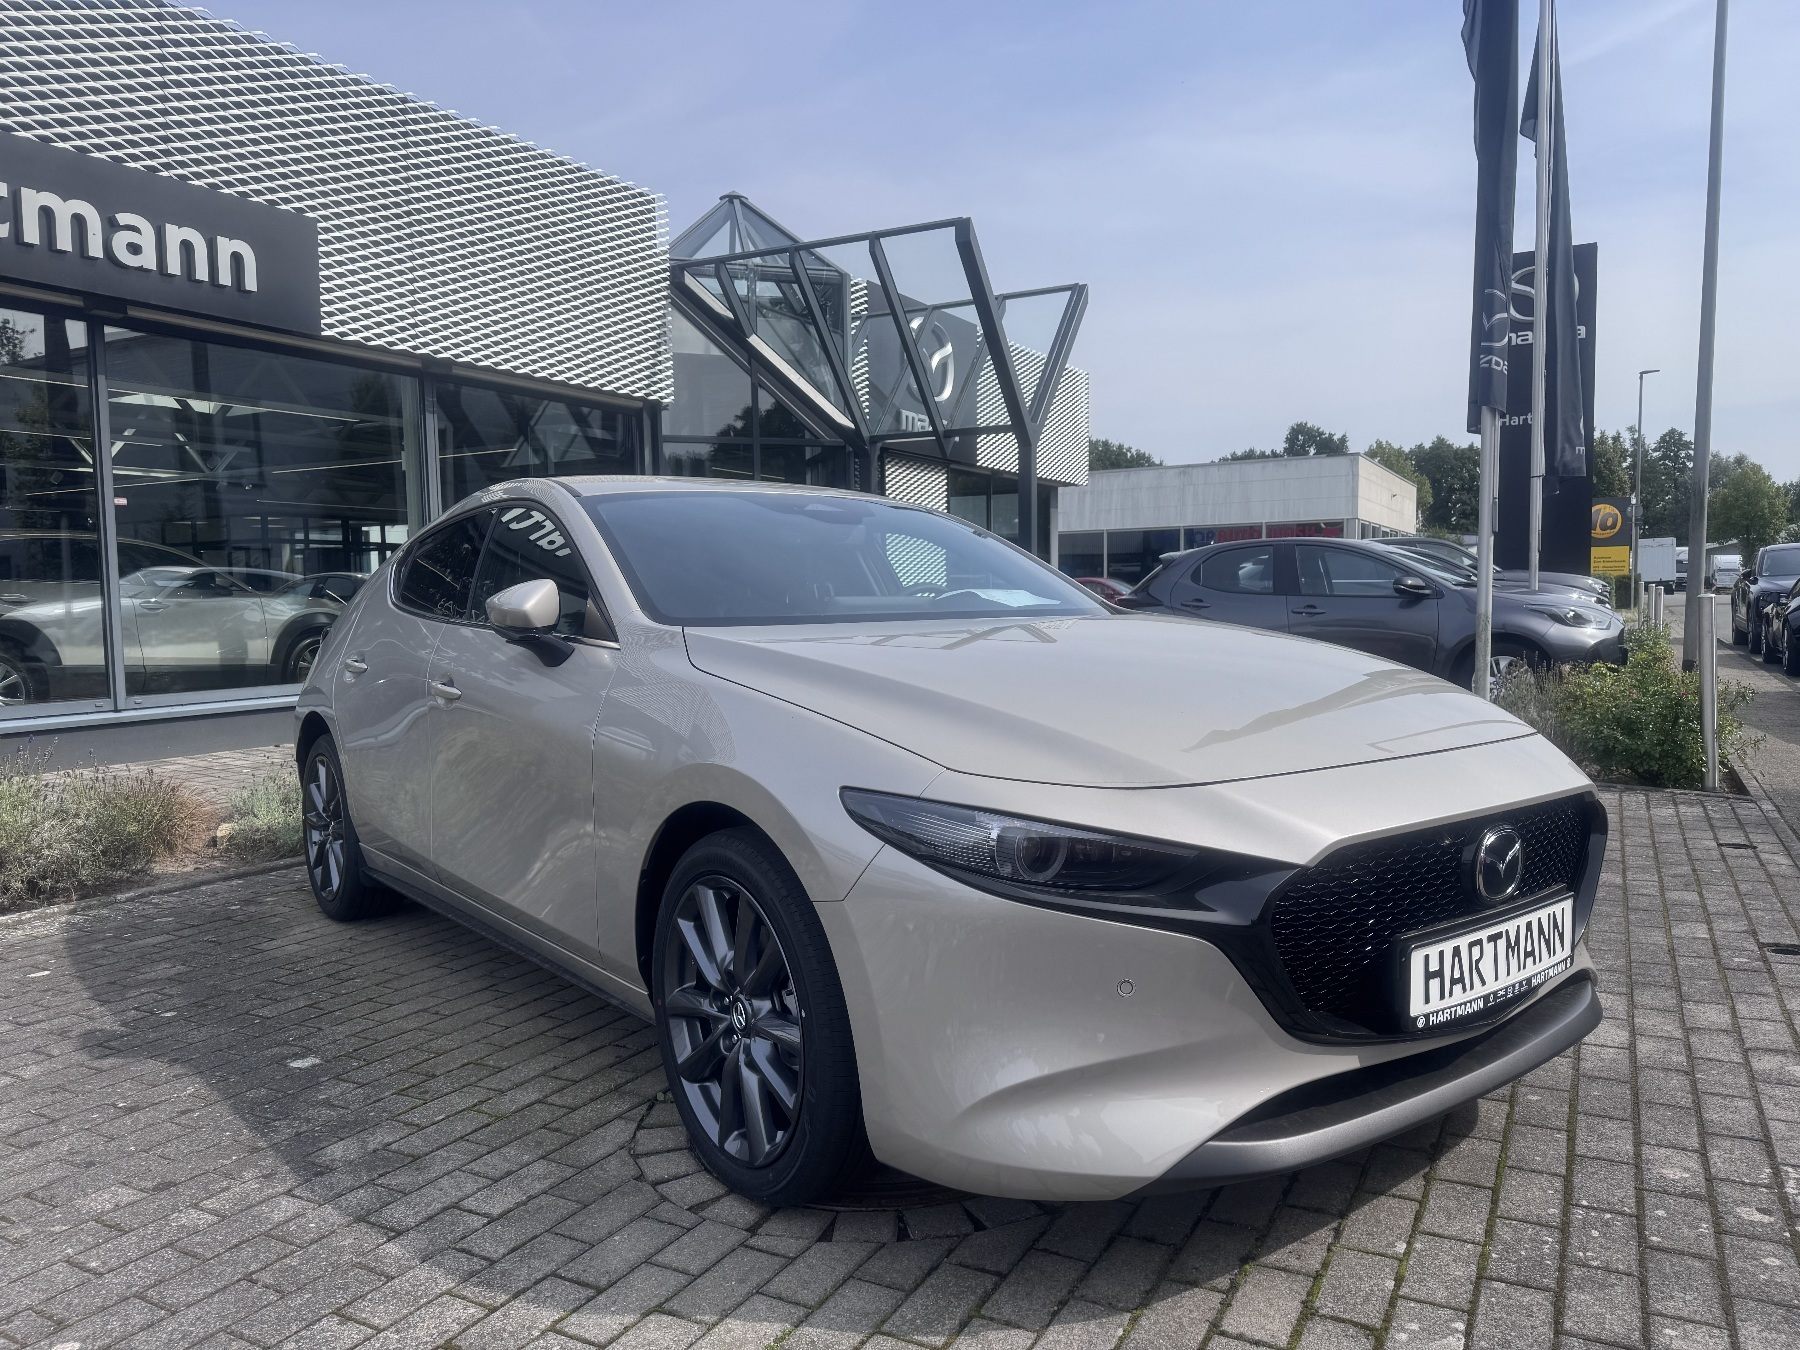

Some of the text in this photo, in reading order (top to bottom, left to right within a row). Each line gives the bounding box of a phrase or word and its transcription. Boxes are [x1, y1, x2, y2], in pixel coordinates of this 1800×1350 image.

[1498, 412, 1533, 427] Hart
[1424, 907, 1565, 1005] HARTMANN
[1429, 960, 1567, 1026] HARTMANN HARTMANN
